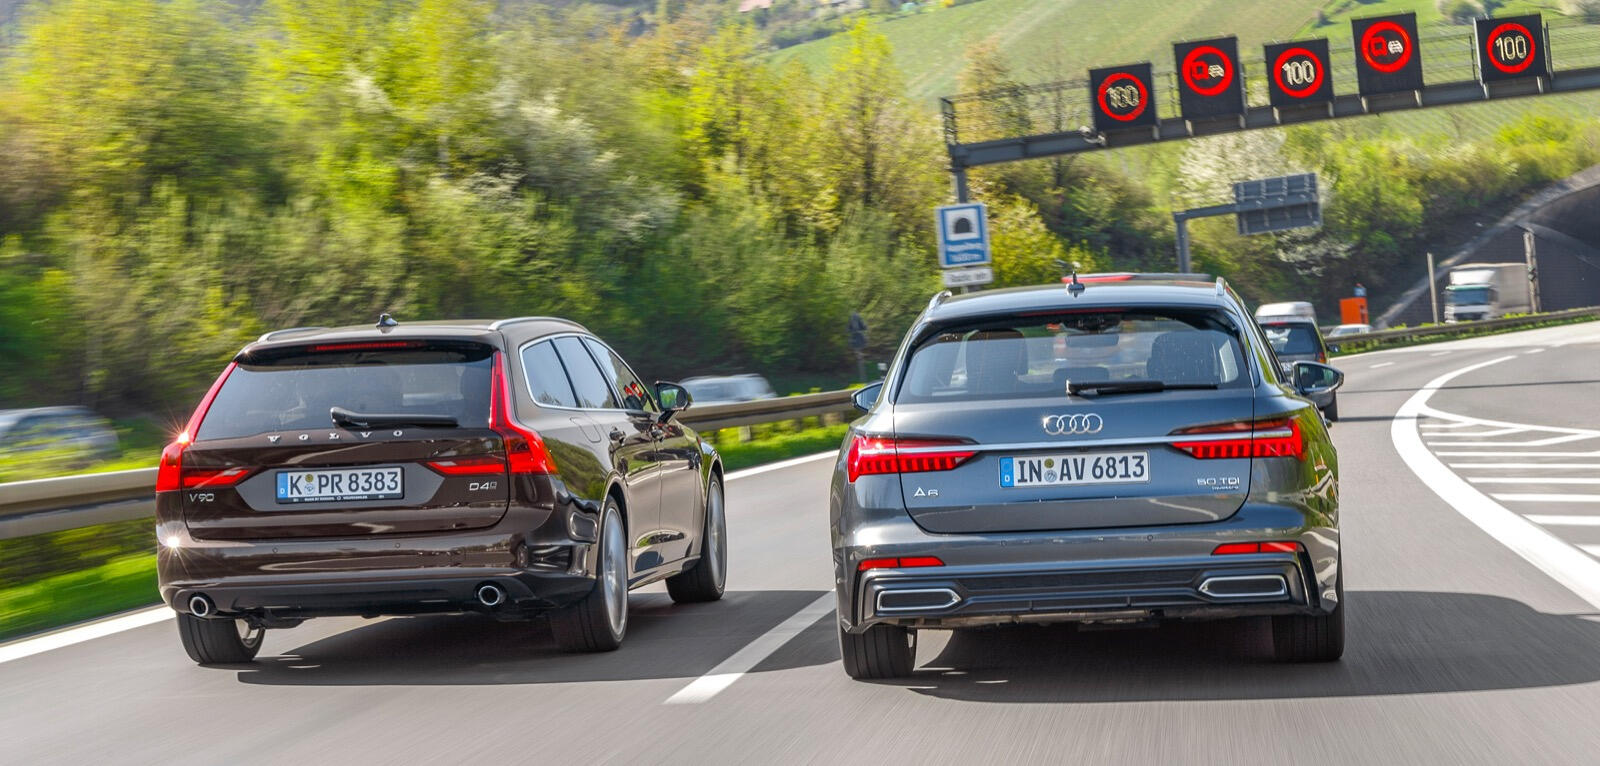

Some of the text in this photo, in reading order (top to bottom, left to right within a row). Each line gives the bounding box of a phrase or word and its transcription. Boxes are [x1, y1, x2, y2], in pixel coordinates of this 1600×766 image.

[1495, 35, 1527, 61] 100
[1282, 60, 1315, 85] 100
[1106, 85, 1139, 108] 100
[267, 431, 403, 442] VOLVO
[1017, 456, 1145, 483] IN AV 6813
[1220, 477, 1240, 485] TDI
[290, 471, 398, 495] K PR 8383
[914, 487, 939, 496] A6
[189, 493, 215, 502] V90
